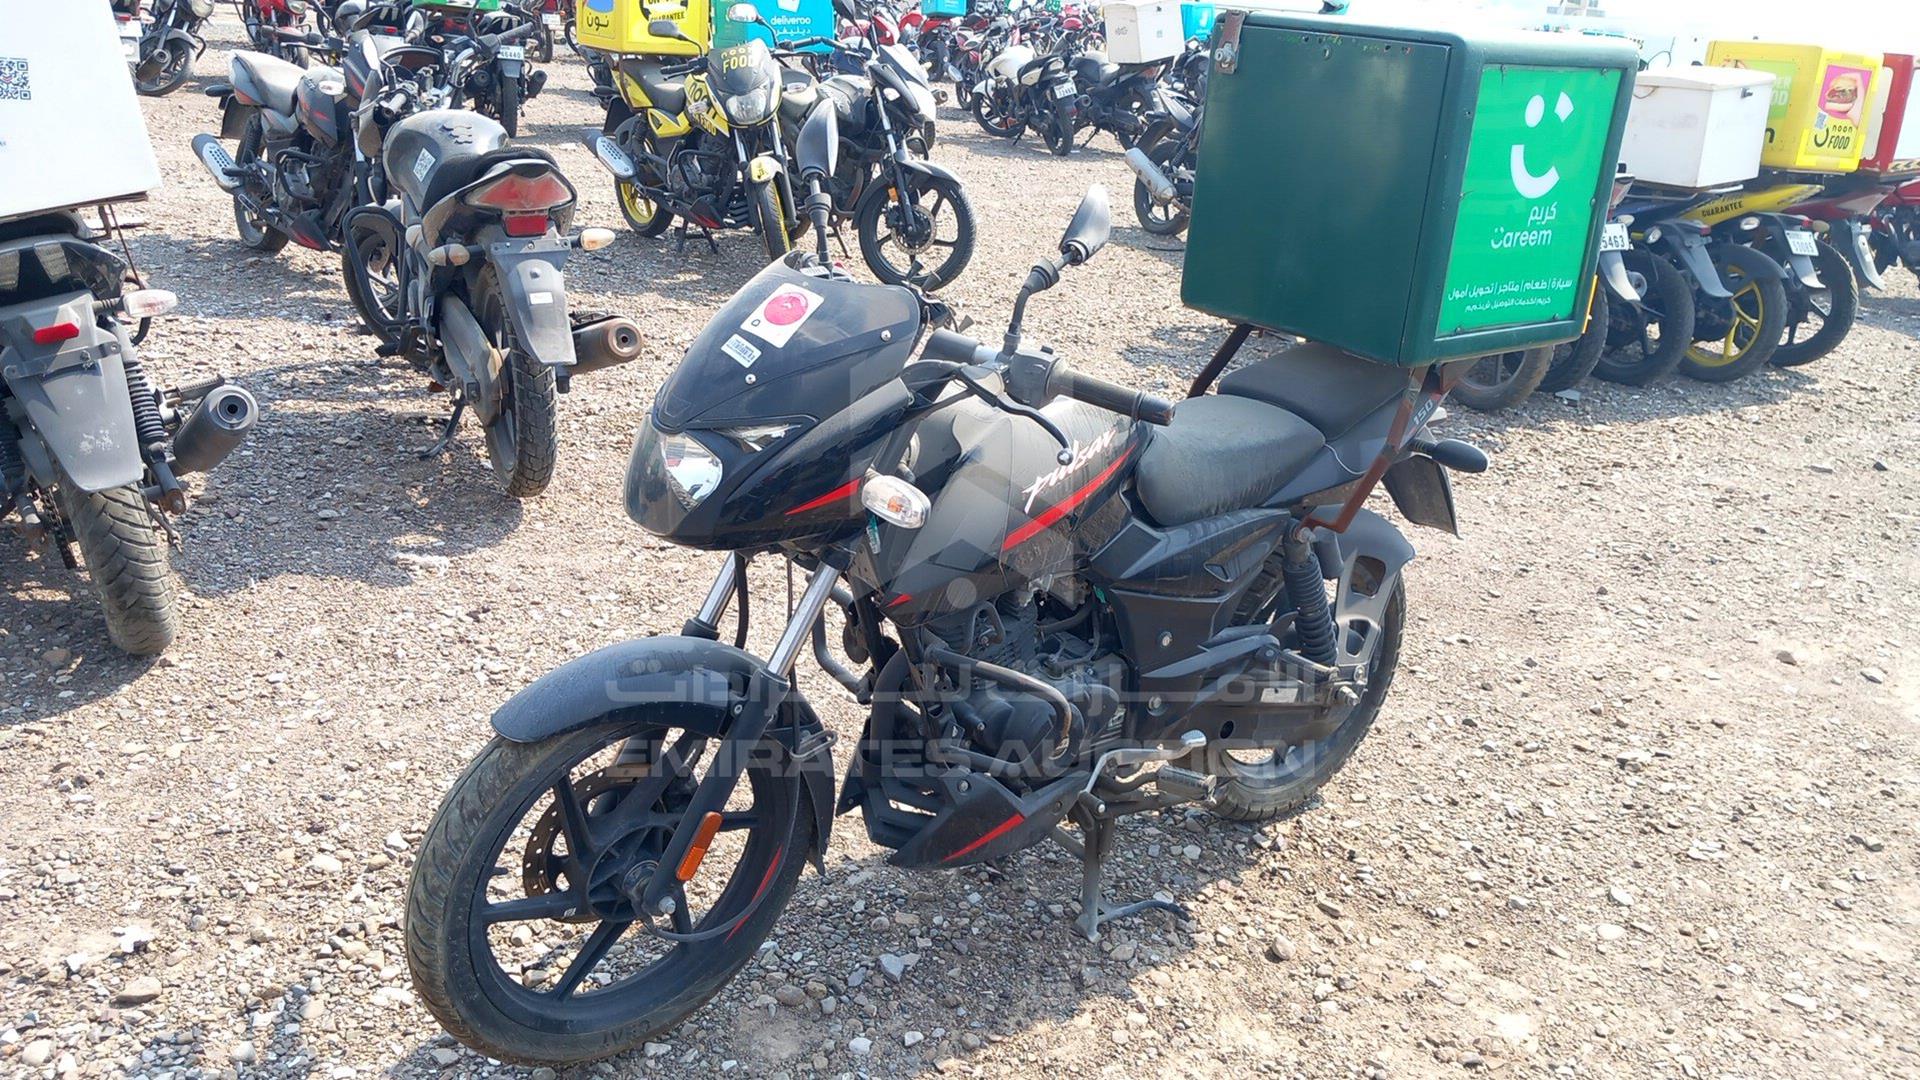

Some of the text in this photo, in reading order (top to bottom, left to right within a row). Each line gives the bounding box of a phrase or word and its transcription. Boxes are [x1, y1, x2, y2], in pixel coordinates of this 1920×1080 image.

[771, 15, 811, 25] deliveroo
[1831, 124, 1853, 133] noon
[1827, 135, 1851, 150] FOOD
[1527, 201, 1558, 227] كريم
[1701, 201, 1744, 218] GUARANTEE
[1490, 226, 1552, 249] Careem
[1413, 399, 1433, 425] 150
